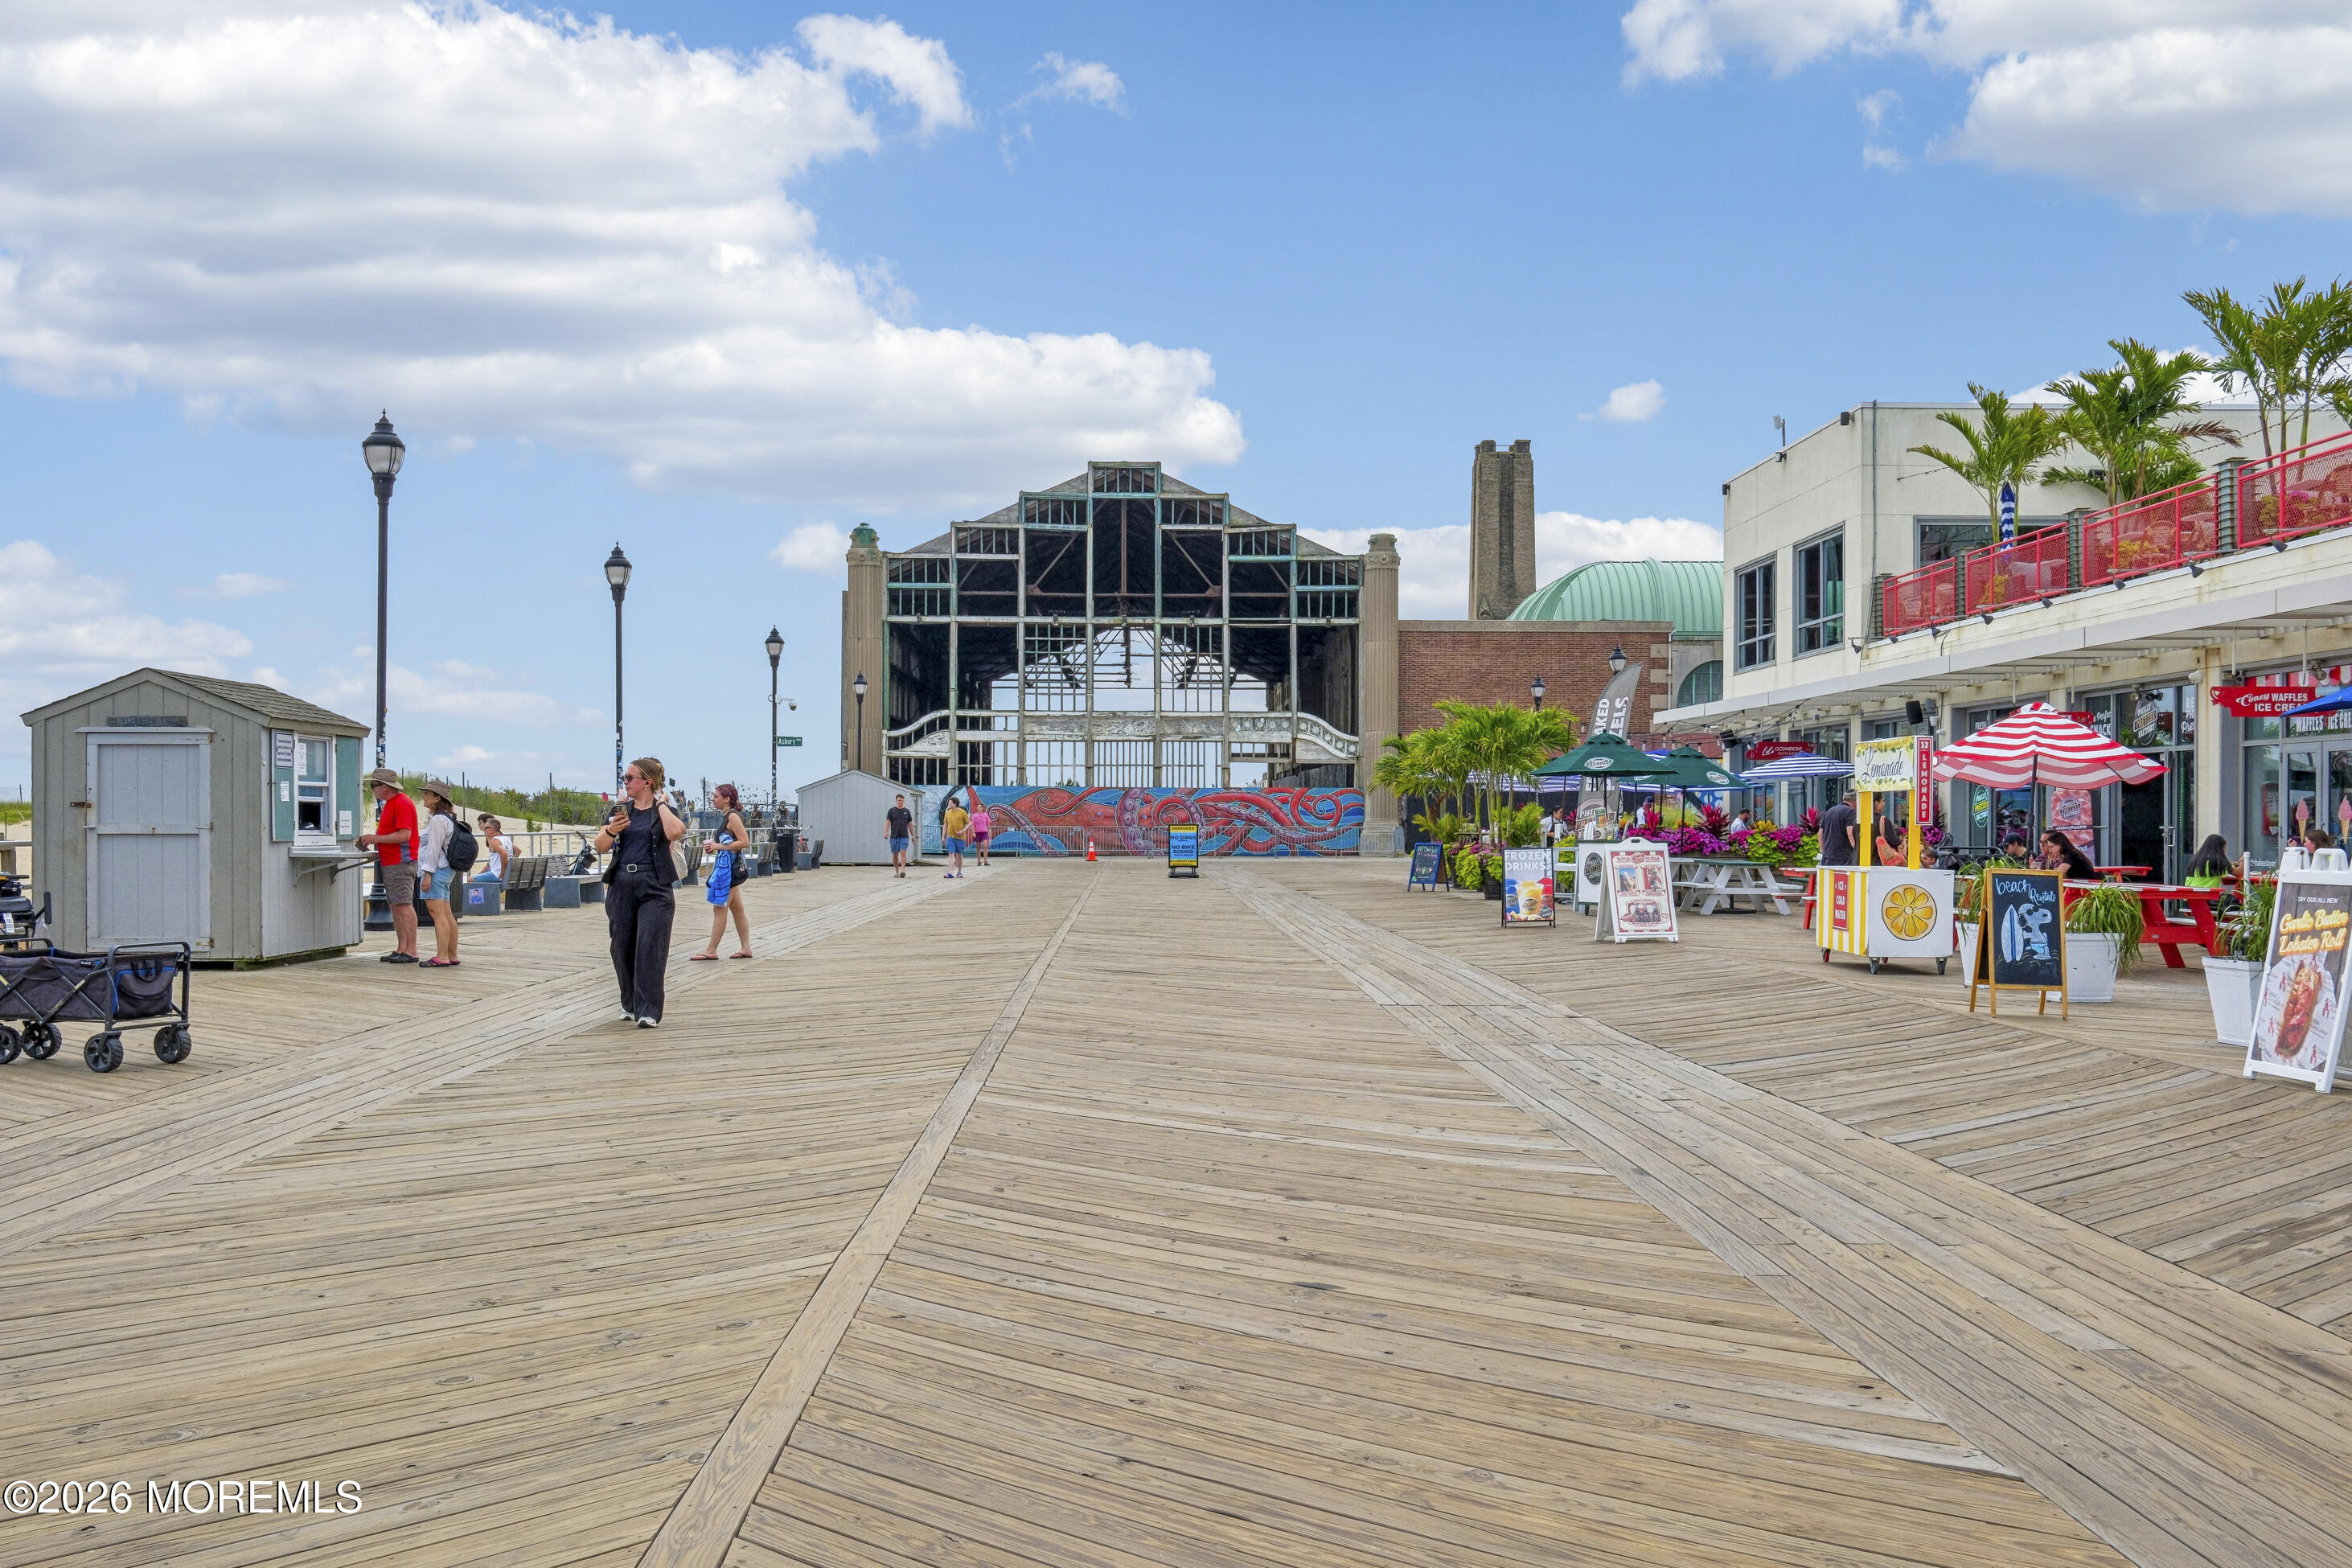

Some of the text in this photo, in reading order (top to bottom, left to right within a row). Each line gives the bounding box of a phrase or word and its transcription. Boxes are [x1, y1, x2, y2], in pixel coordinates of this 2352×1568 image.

[2235, 692, 2308, 707] Coney WAFFLES
[2254, 703, 2306, 712] ICE CREA
[1593, 698, 1610, 736] AKED
[2137, 703, 2151, 716] PHILLY
[2136, 713, 2156, 729] PRETZEL
[2296, 715, 2324, 733] WAFFLES
[2328, 715, 2339, 729] ICE
[2138, 724, 2155, 738] FACTORY
[1920, 741, 1928, 749] 32
[1861, 746, 1903, 785] Lemonade
[1920, 753, 1928, 819] LEMONADE
[1505, 851, 1550, 860] FROZEN
[1995, 878, 2031, 896] beach
[1836, 895, 1845, 905] COLD
[2030, 888, 2056, 905] Rentals
[1835, 909, 1846, 920] WATER
[2279, 909, 2349, 934] Garlic Butter
[2279, 927, 2348, 956] Lobster Roll
